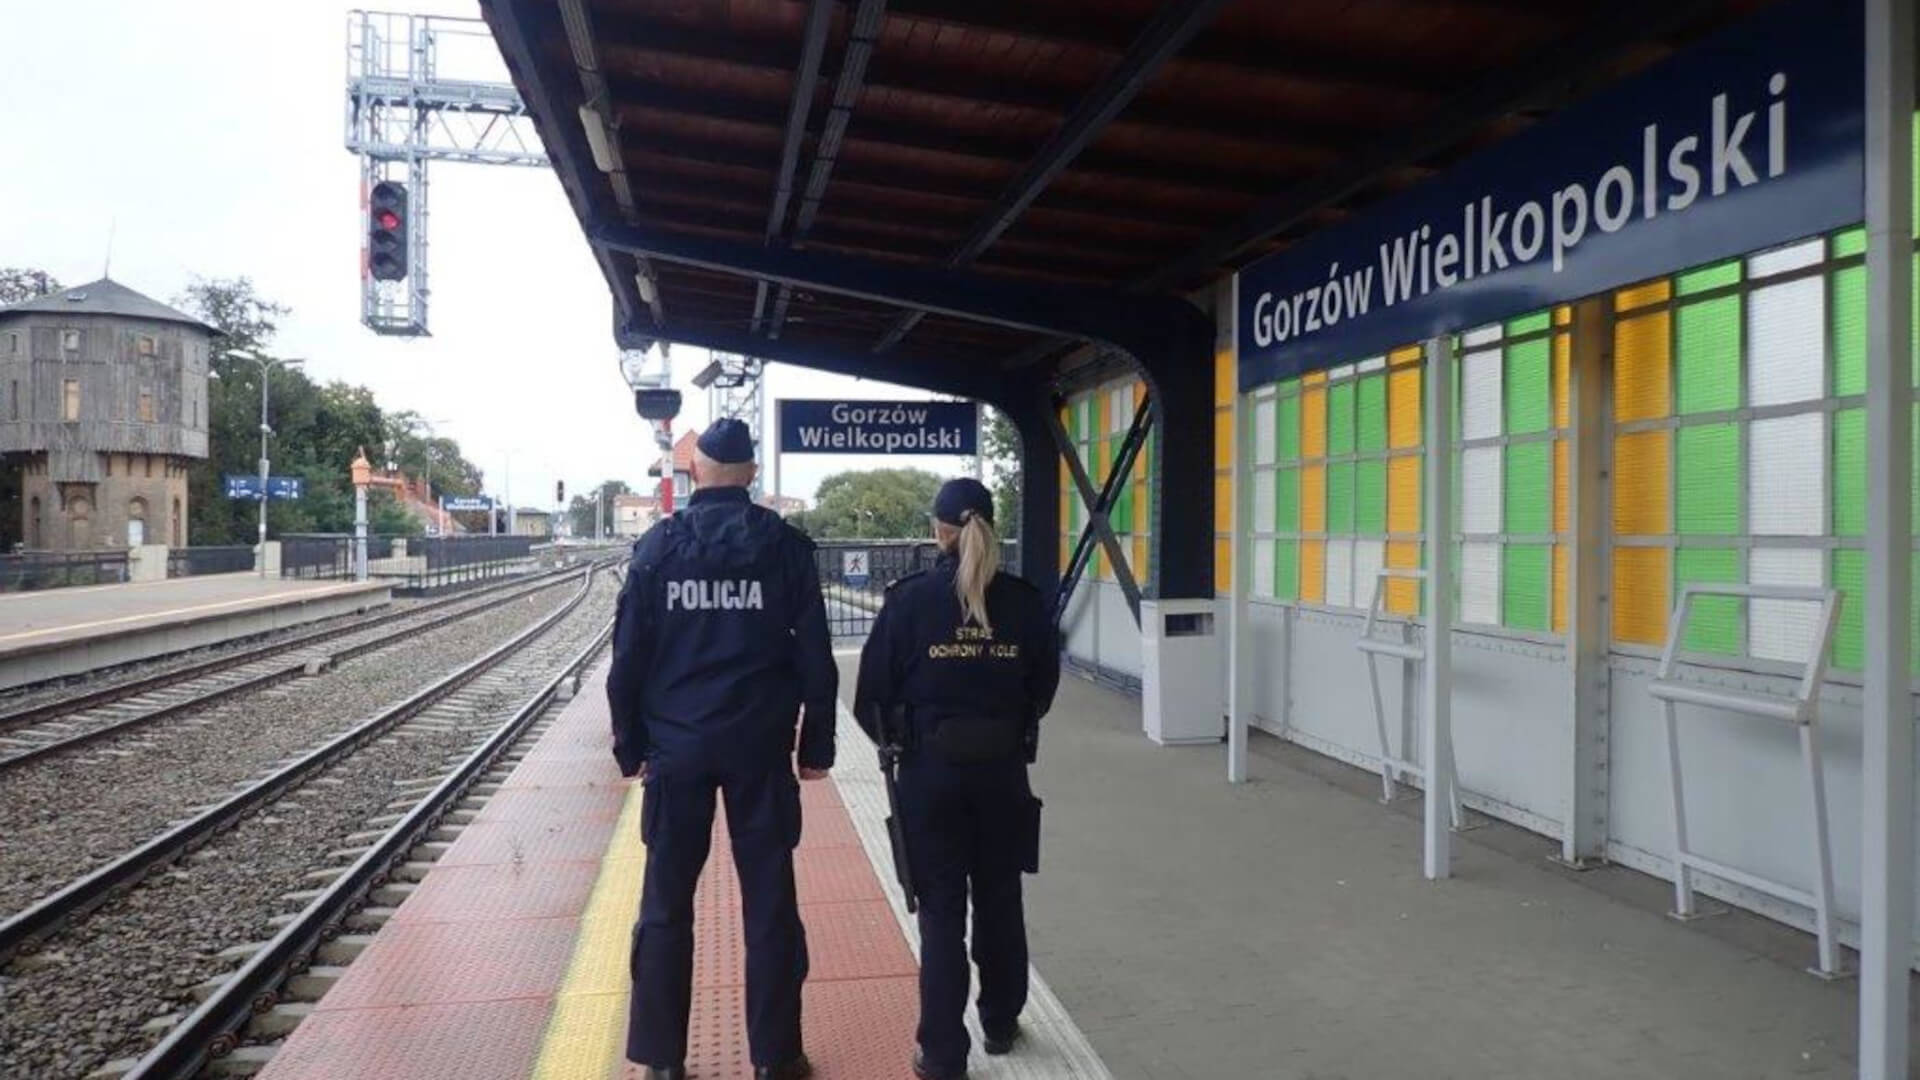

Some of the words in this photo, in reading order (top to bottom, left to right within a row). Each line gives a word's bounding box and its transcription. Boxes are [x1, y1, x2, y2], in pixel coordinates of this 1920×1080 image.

[1253, 262, 1374, 348] Gorzów
[1380, 72, 1787, 307] Wielkopolski
[831, 402, 928, 425] Gorzów
[798, 425, 962, 452] Wielkopolski
[666, 579, 764, 611] POLICJA
[928, 644, 984, 658] OCHRONY
